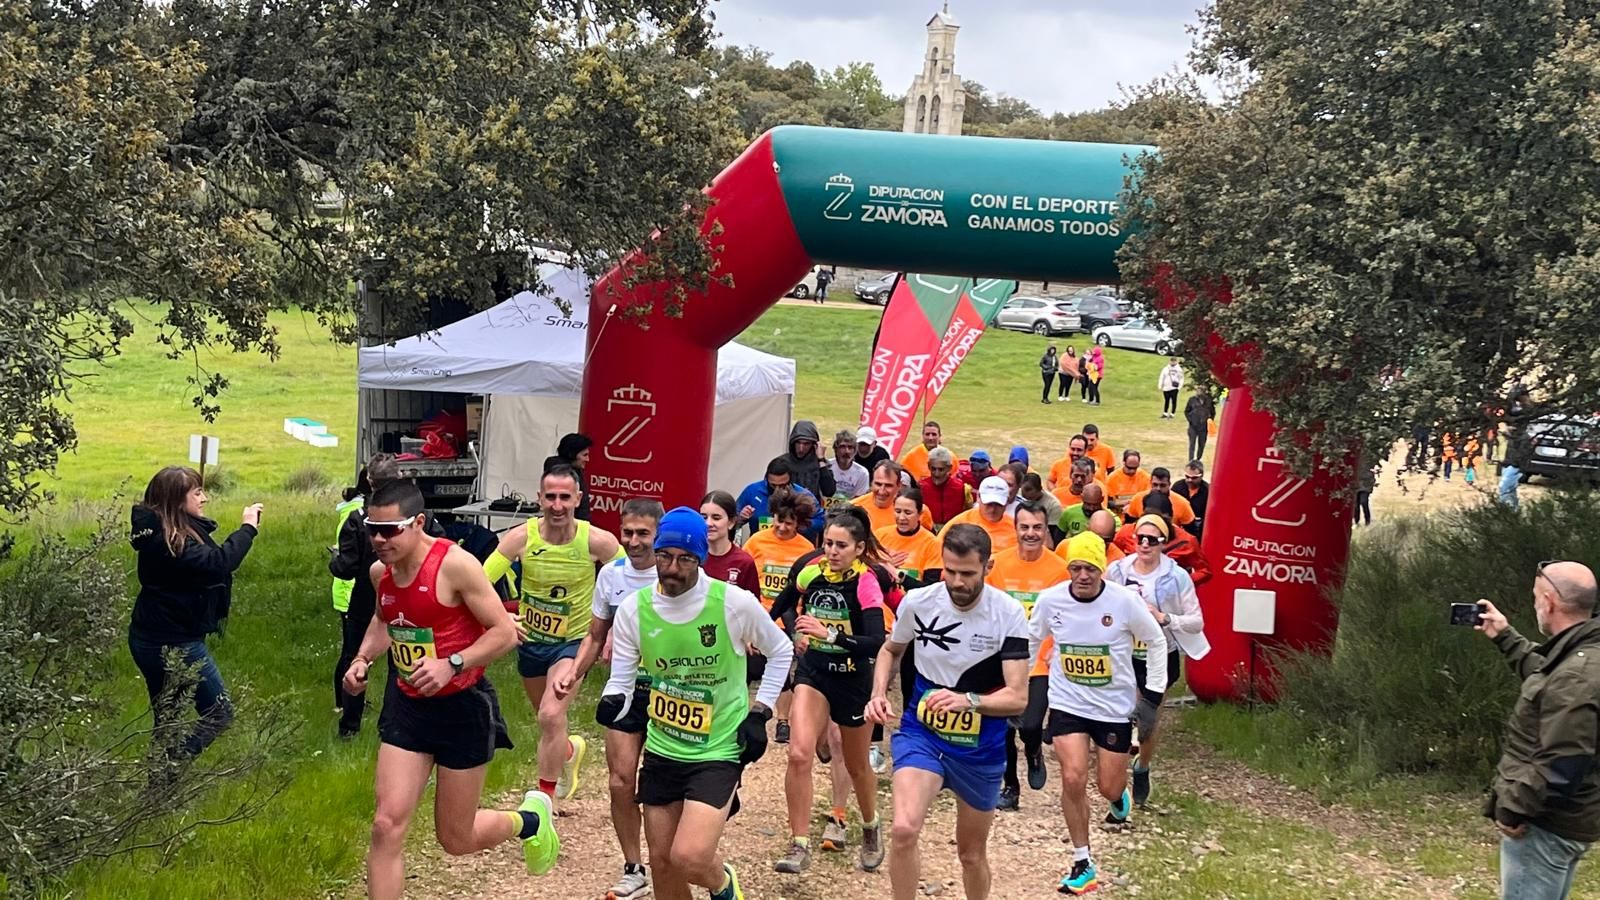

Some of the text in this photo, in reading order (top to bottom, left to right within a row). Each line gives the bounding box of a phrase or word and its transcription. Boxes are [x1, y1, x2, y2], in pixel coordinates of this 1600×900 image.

[861, 204, 948, 227] ZAMORA
[970, 193, 1119, 215] CON EL DEPORTE
[967, 214, 1120, 237] GANAMOS TODOS
[544, 315, 589, 330] Smar
[927, 327, 982, 395] ZAMORA
[876, 353, 931, 456] AMORA
[1223, 555, 1318, 585] ZAMORA
[765, 574, 789, 591] 099
[526, 607, 563, 634] 0997
[828, 657, 857, 673] nak
[1065, 657, 1106, 675] 0984
[655, 695, 704, 730] 0995
[922, 707, 973, 731] 0979
